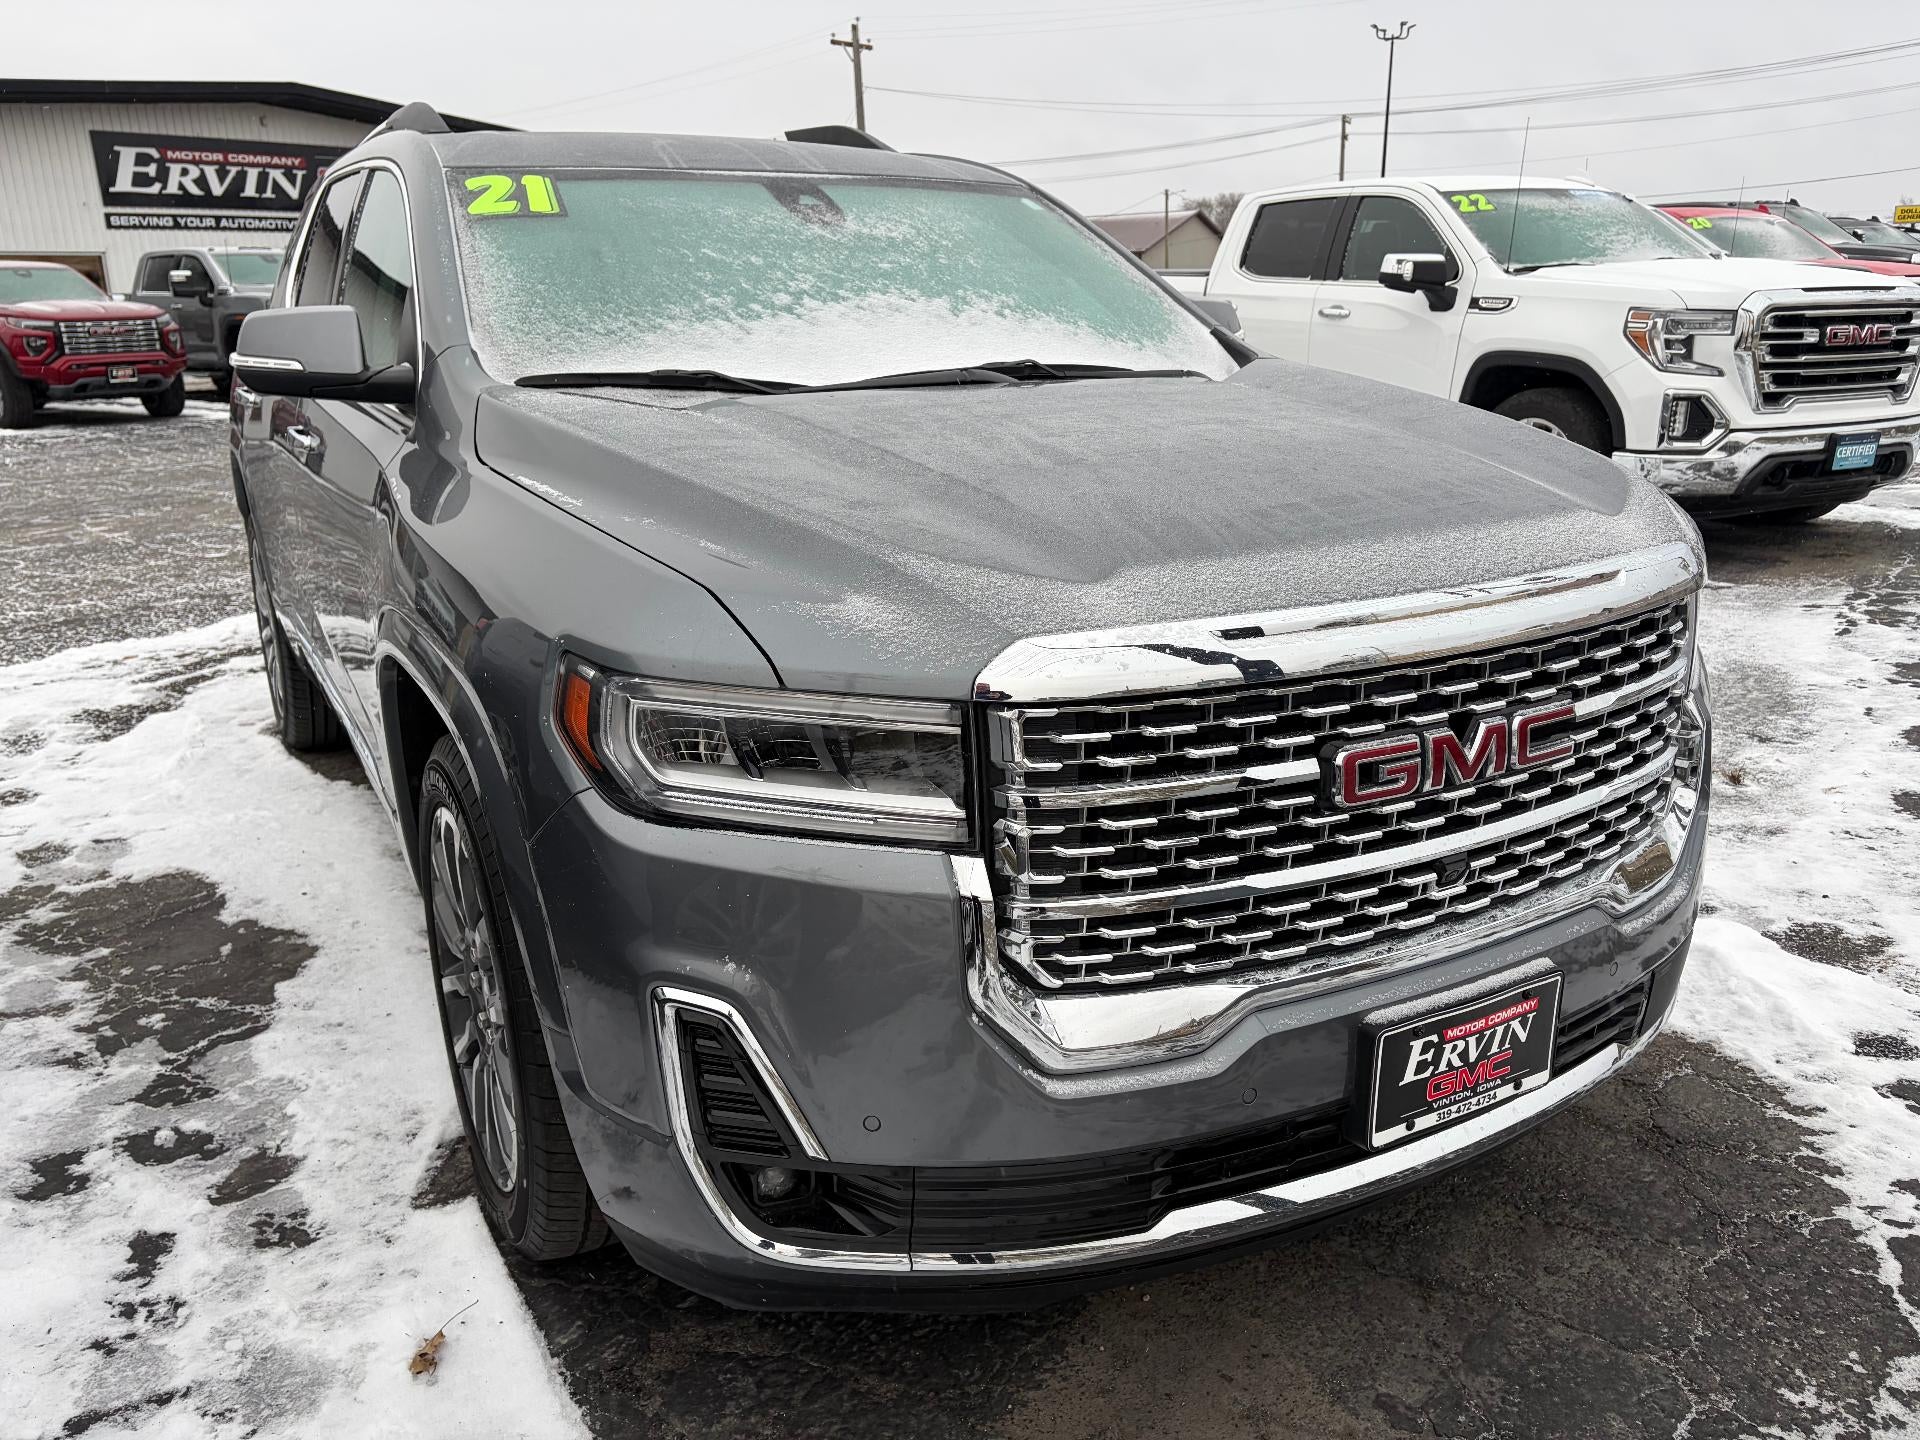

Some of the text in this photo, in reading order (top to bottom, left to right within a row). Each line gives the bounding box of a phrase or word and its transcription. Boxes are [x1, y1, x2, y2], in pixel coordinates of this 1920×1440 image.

[108, 144, 308, 200] ERVIN
[166, 149, 301, 167] MOTOR COMPANY
[464, 174, 561, 216] 21
[1450, 193, 1496, 213] 22
[110, 214, 297, 231] SERVING YOUR AUTOMOTIV
[1686, 216, 1713, 230] 20
[1826, 324, 1894, 345] GMC
[1837, 444, 1876, 458] CERTIFIED
[1334, 700, 1576, 808] GMC
[1446, 999, 1538, 1040] MOTOR COMPANY
[1399, 1012, 1537, 1086] ERVIN
[1426, 1050, 1513, 1102] GMC
[1432, 1079, 1502, 1109] VINTON, IOWA
[1435, 1091, 1498, 1122] 319-472-4734
